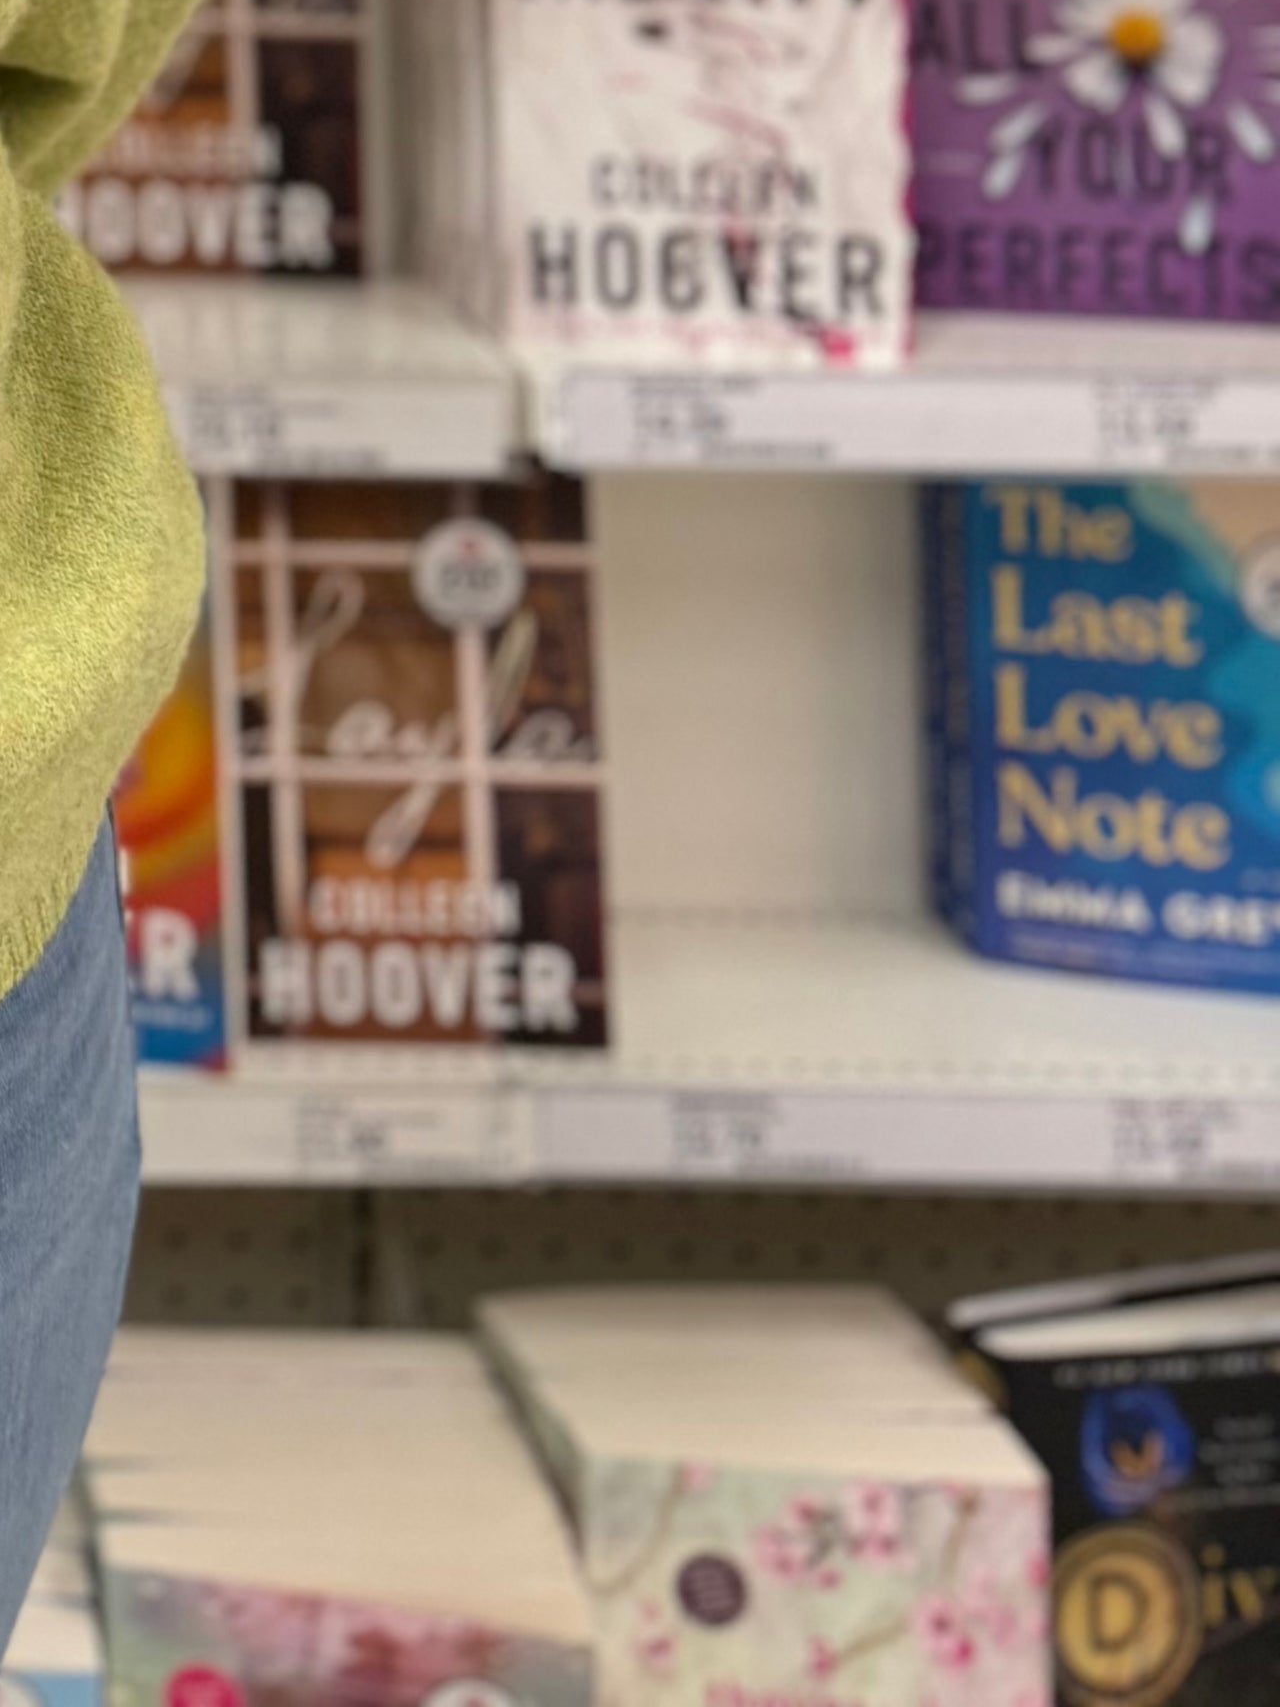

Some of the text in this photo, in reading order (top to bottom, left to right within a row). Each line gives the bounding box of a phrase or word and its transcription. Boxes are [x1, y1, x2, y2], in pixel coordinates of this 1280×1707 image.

[984, 481, 1134, 563] The
[990, 563, 1204, 669] Last
[994, 661, 1226, 771] Love
[996, 757, 1234, 873] Note
[308, 875, 524, 939] COLLEEN
[256, 935, 582, 1035] HOOVER
